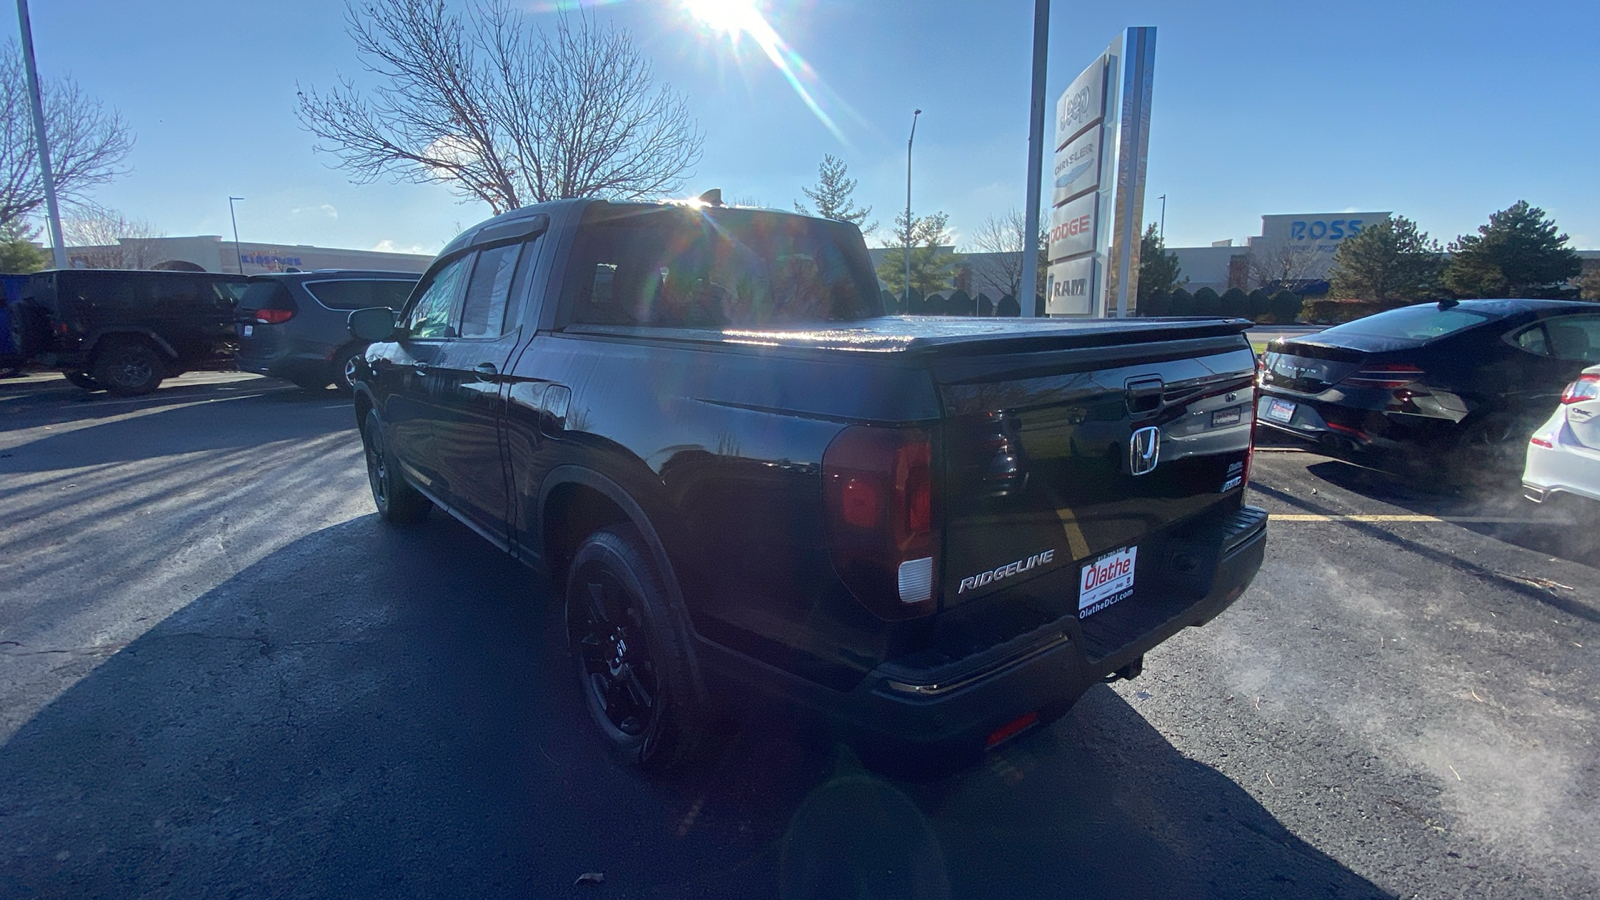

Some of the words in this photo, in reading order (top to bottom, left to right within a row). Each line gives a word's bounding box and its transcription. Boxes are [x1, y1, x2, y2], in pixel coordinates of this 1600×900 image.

[1054, 143, 1094, 176] CHRYSLER
[1050, 214, 1090, 244] DODGE
[1291, 219, 1363, 240] ROSS
[1054, 278, 1087, 297] RAM
[958, 549, 1055, 595] RIDGELINE
[1085, 557, 1131, 590] Olathe
[1079, 588, 1134, 619] OlatheDCJ.com
